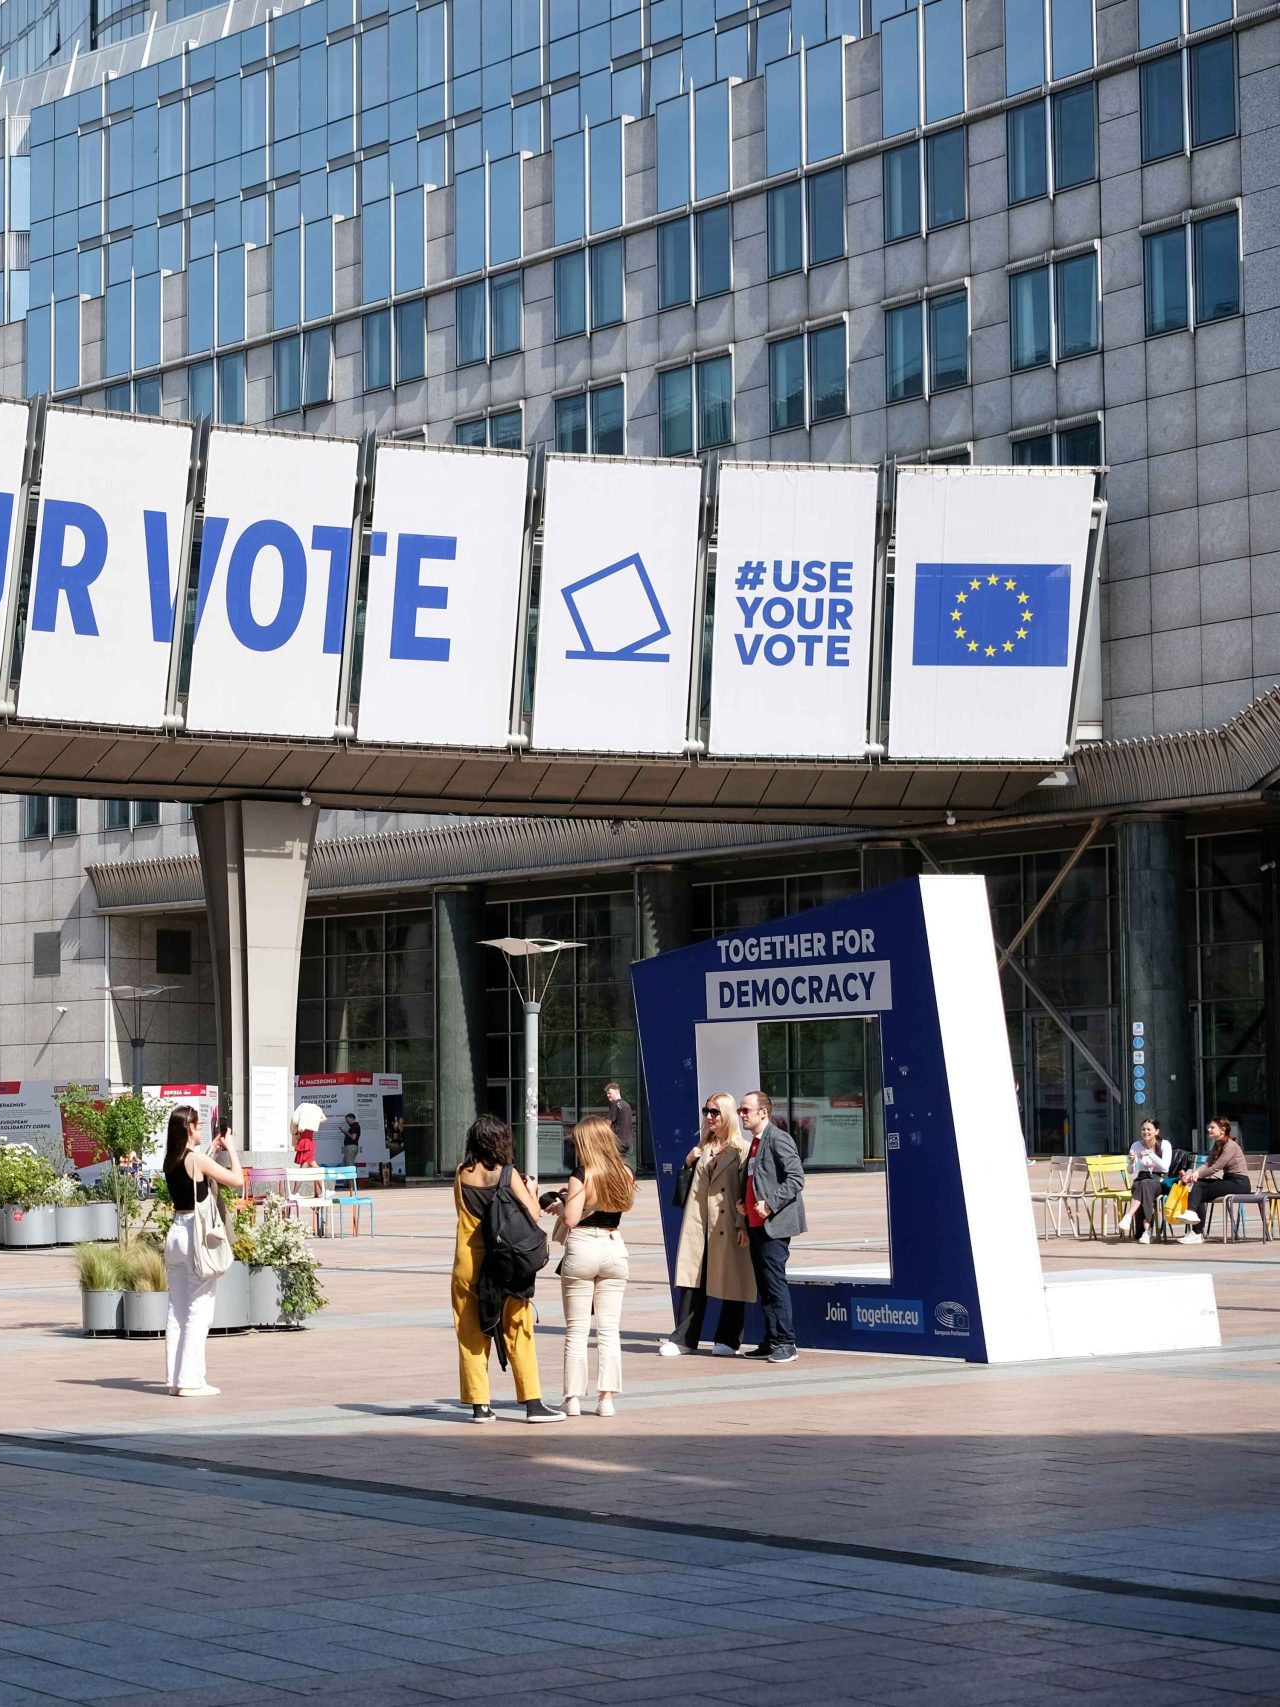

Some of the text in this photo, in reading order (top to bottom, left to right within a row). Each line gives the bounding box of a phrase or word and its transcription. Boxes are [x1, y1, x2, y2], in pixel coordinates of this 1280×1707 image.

[143, 510, 457, 662] VOTE
[735, 560, 853, 593] #USE
[736, 597, 853, 630] YOUR
[734, 634, 850, 667] VOTE
[717, 928, 875, 963] TOGETHER FOR
[719, 972, 875, 1008] DEMOCRACY
[825, 1302, 919, 1327] Join together.eu
[934, 1329, 970, 1337] European Parliament
